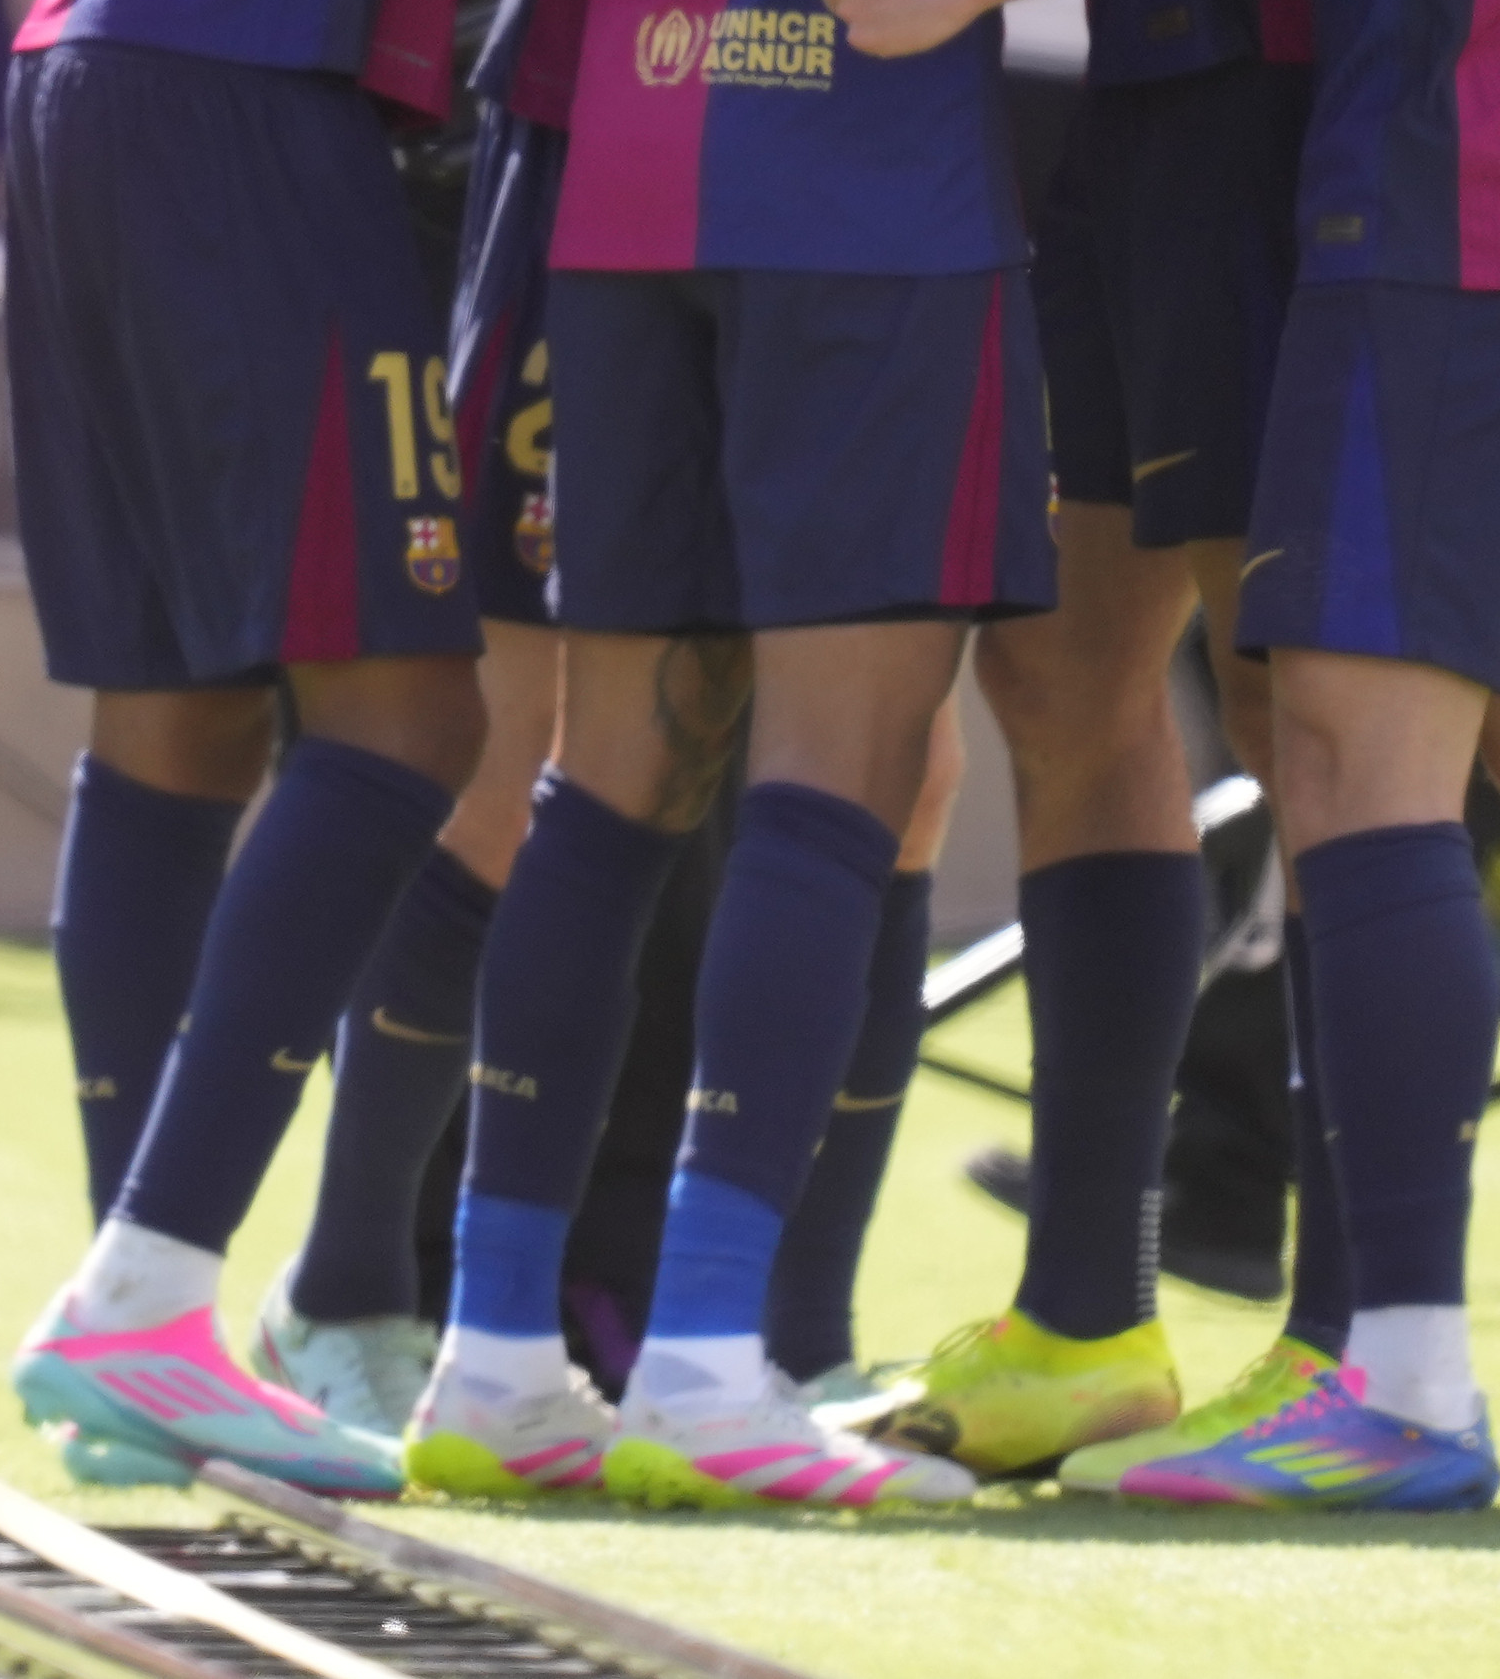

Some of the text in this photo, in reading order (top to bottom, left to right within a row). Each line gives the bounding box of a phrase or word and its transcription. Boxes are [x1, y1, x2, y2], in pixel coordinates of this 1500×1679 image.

[708, 7, 836, 47] UNHCR
[700, 38, 834, 78] ACNUR
[368, 350, 463, 500] 19
